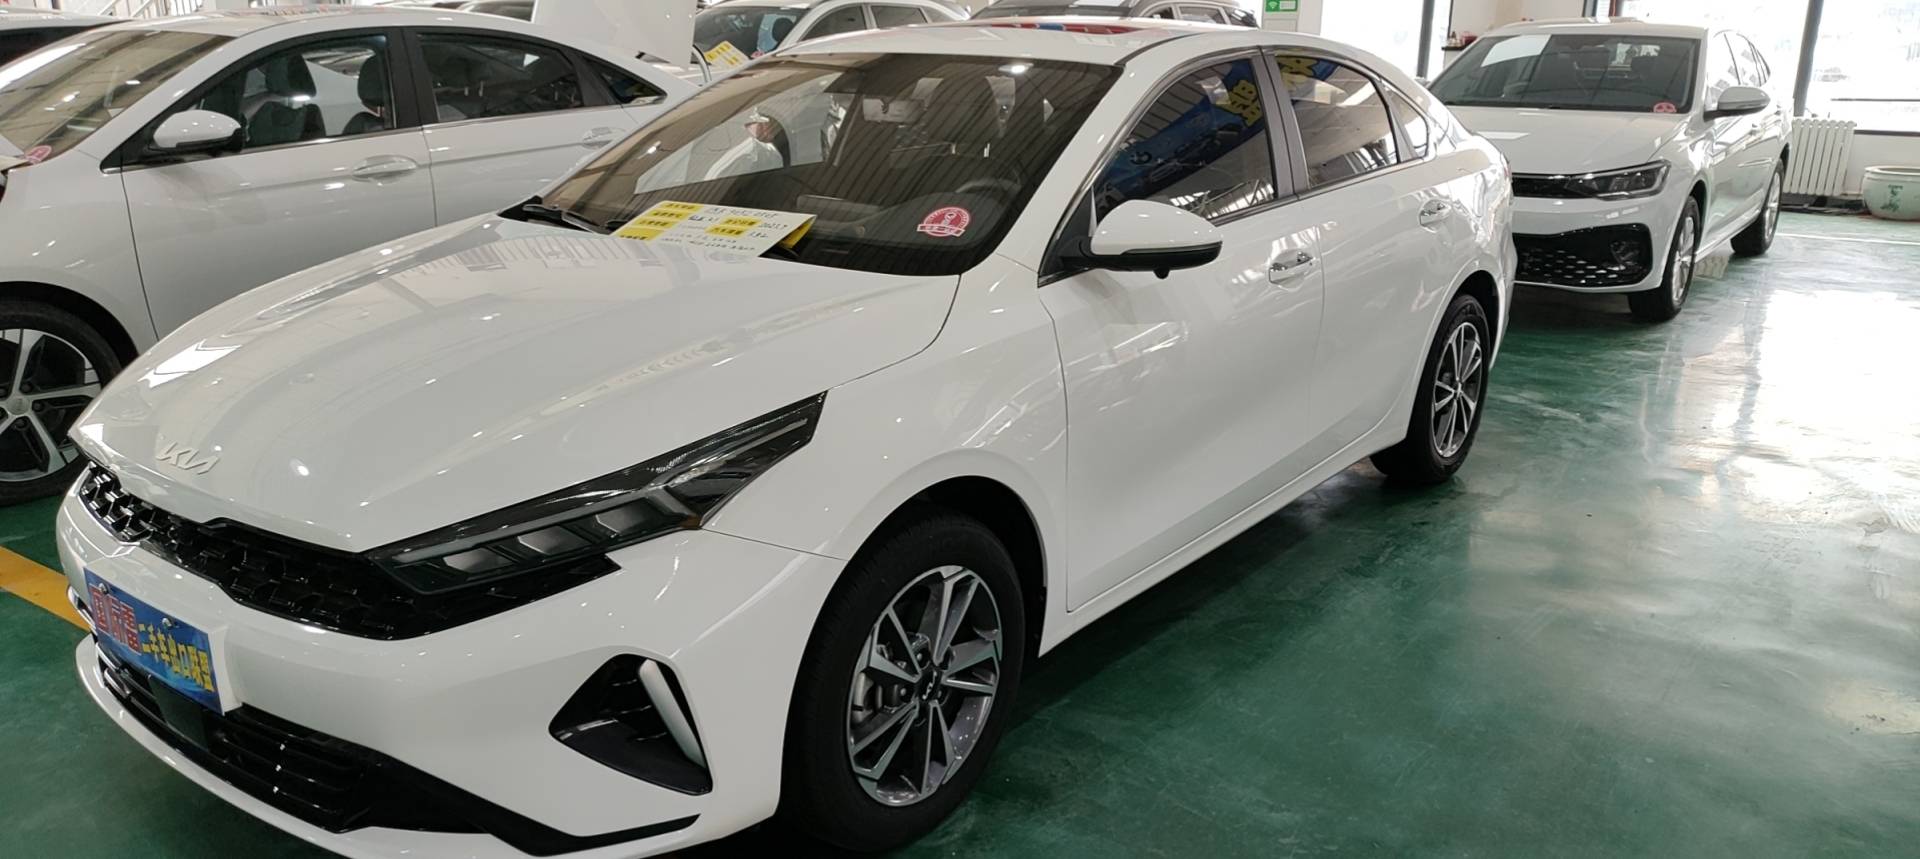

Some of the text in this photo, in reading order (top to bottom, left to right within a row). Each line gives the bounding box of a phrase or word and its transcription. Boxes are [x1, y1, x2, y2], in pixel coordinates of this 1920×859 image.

[156, 441, 221, 475] KIA
[138, 623, 215, 692] 二手车出口联盟
